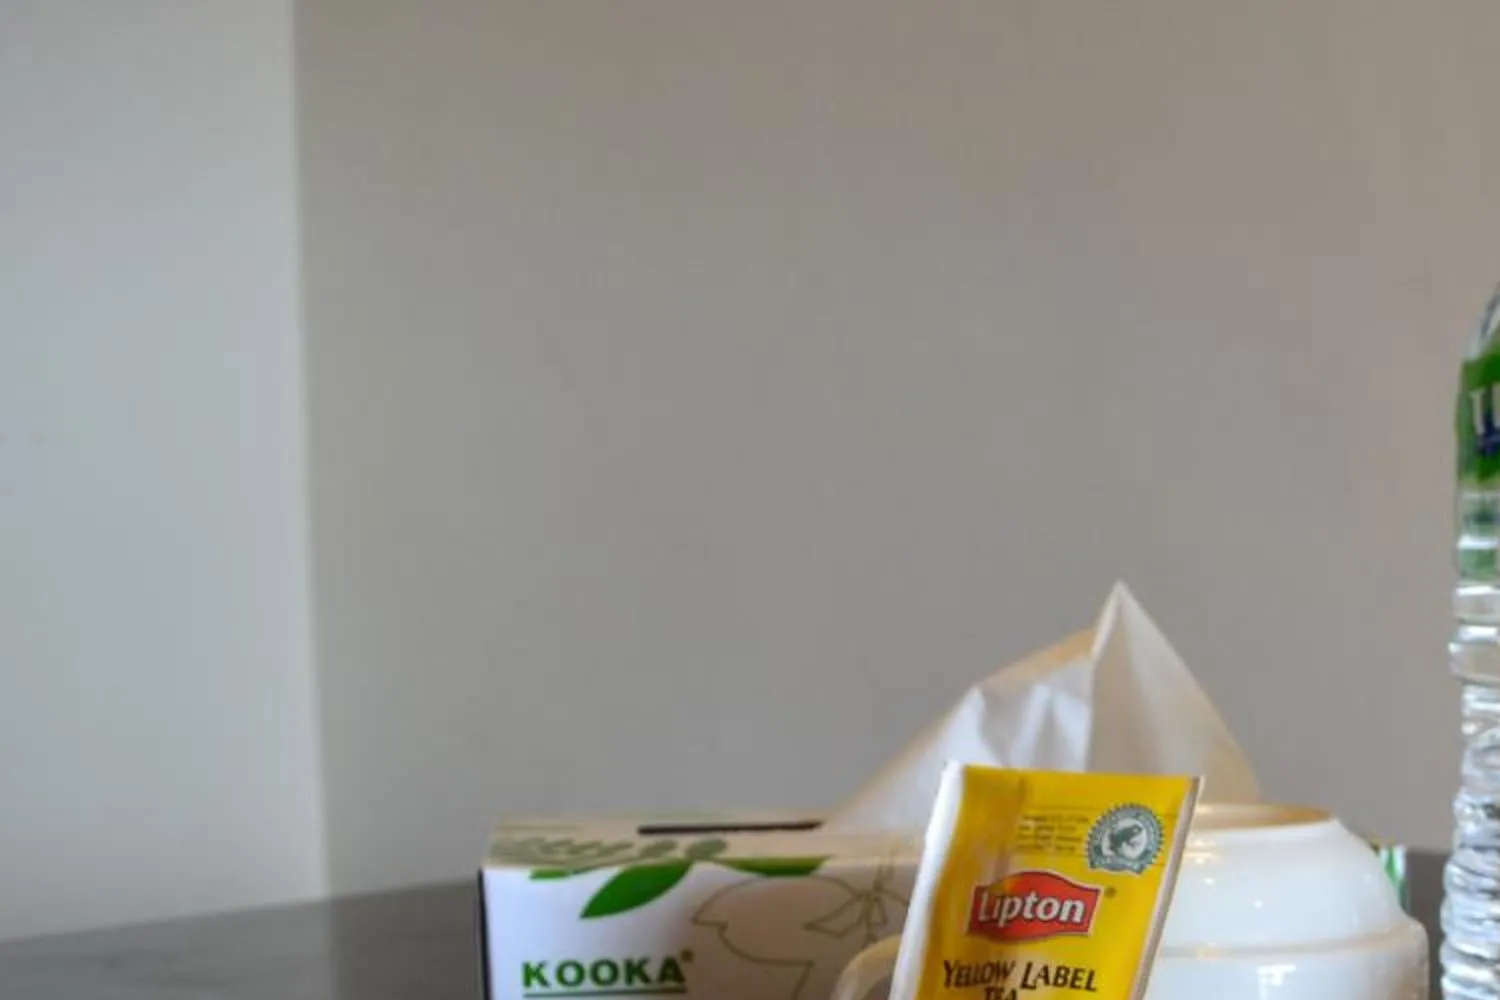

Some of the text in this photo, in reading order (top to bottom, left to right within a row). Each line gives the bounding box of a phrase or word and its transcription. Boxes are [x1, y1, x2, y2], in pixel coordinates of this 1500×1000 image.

[978, 891, 1085, 927] Lipton
[521, 956, 686, 988] KOOKA
[1020, 962, 1098, 991] LABEL
